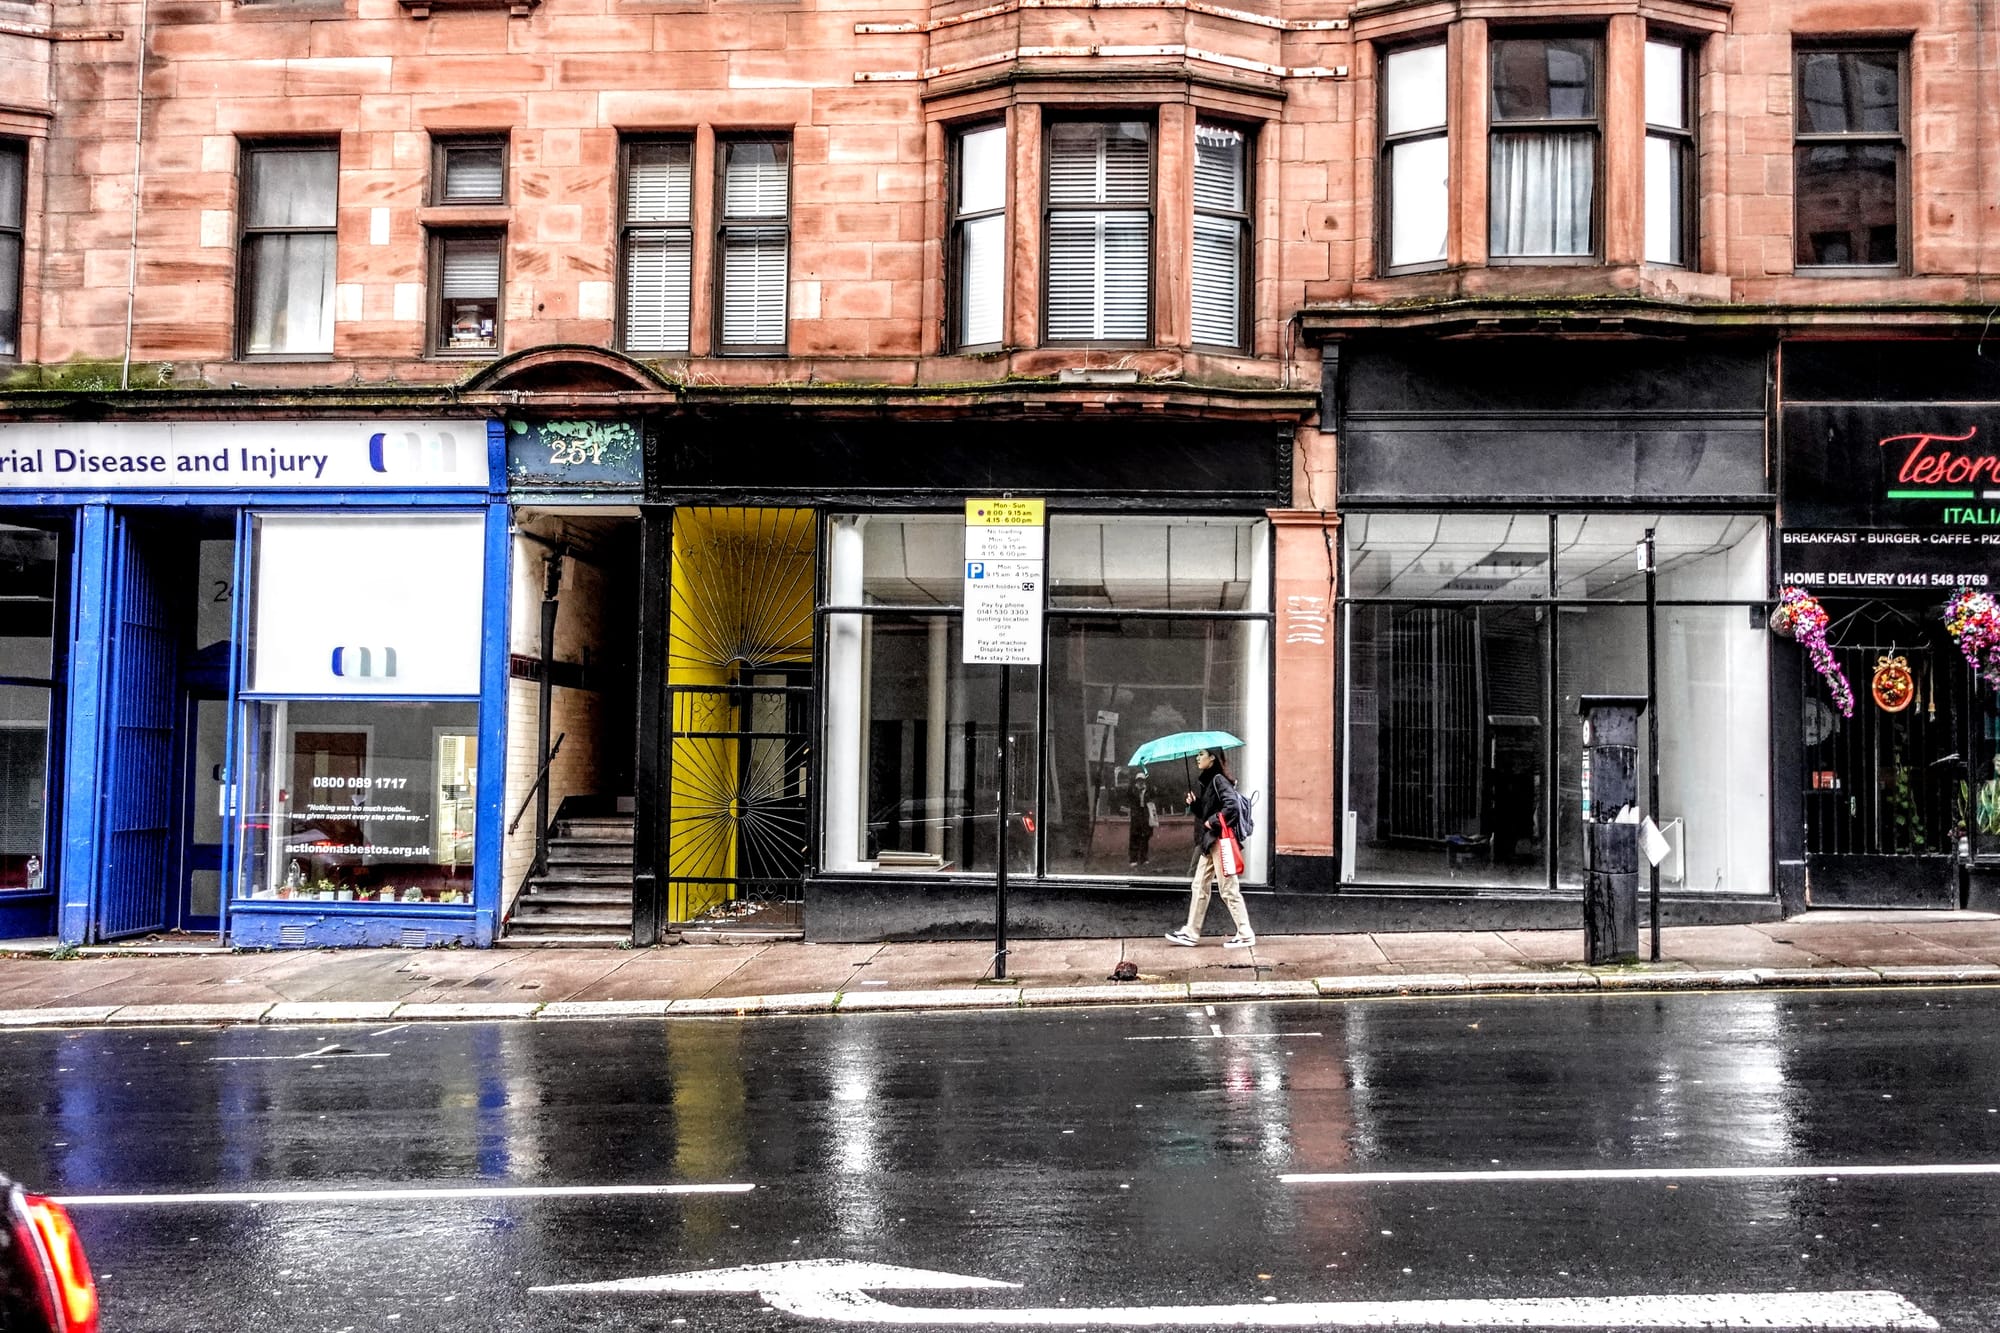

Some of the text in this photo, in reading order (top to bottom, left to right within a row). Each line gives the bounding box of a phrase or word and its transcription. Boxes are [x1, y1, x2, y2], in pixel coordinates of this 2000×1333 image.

[549, 440, 602, 465] 251
[54, 448, 167, 473] Disease
[177, 448, 229, 472] and
[241, 448, 329, 479] Injury
[1783, 532, 1857, 544] BREAKFAST
[1867, 533, 1920, 544] BURGER
[1930, 533, 1971, 544] CAFFE
[971, 563, 983, 578] P
[1784, 572, 1988, 586] HOME DELIVERY 0141 548 8769
[313, 776, 407, 789] 0800 089 1717
[306, 812, 326, 820] given
[325, 813, 352, 821] support
[371, 814, 386, 822] step
[285, 843, 430, 857] actiononasbestos.org.uk
